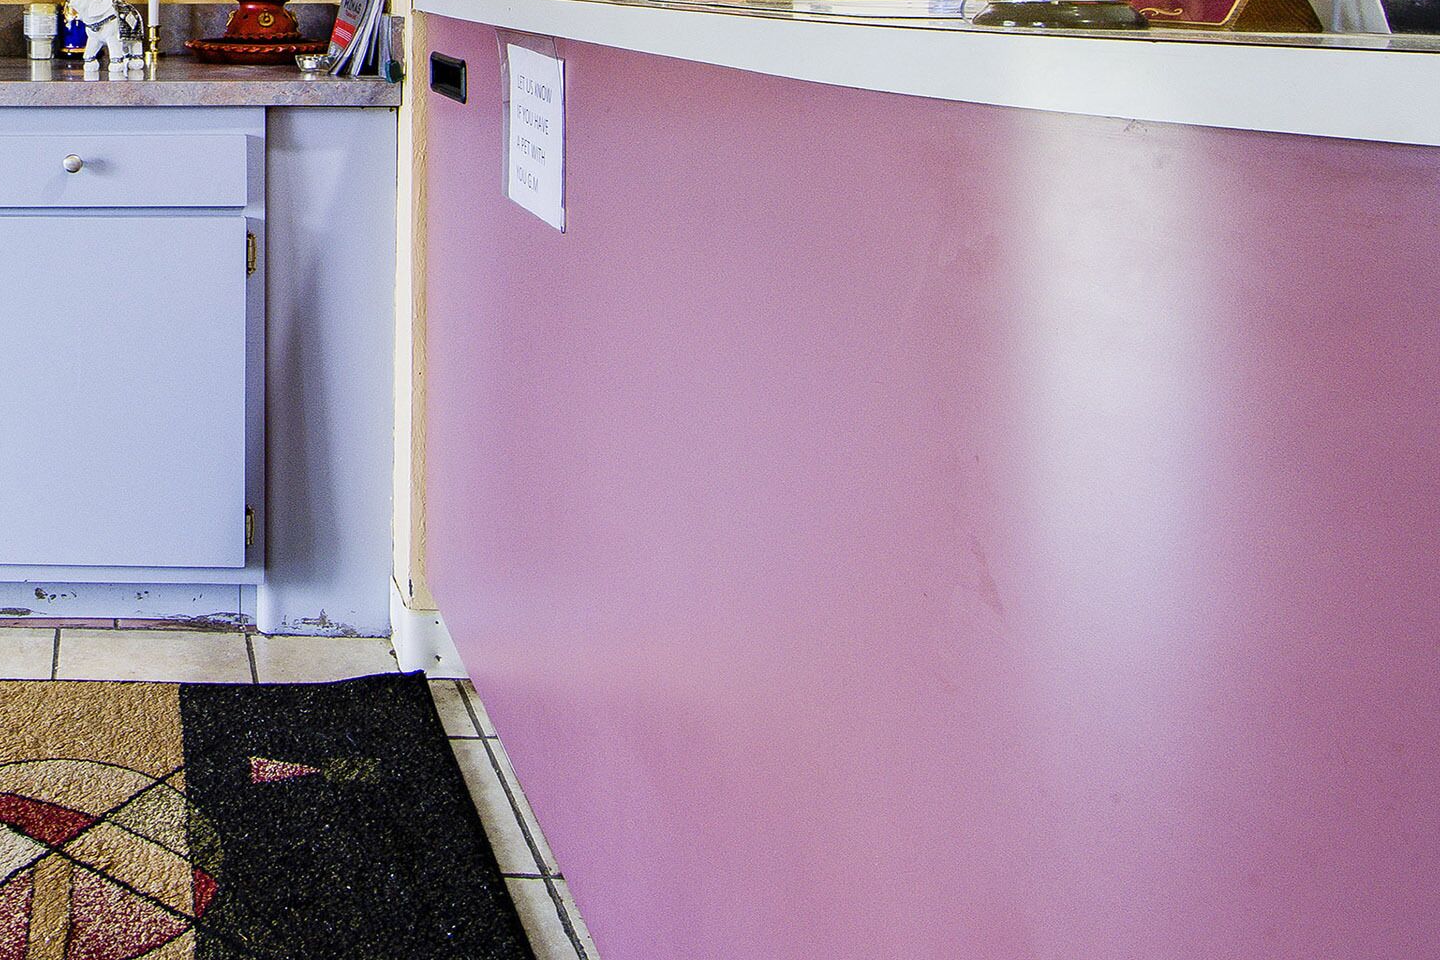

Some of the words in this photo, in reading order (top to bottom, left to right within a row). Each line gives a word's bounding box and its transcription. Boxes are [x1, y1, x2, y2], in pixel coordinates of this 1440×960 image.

[526, 78, 533, 95] US
[534, 84, 552, 104] KNOW
[522, 107, 533, 127] YOU
[534, 113, 549, 136] HAVE
[531, 143, 546, 167] WITH
